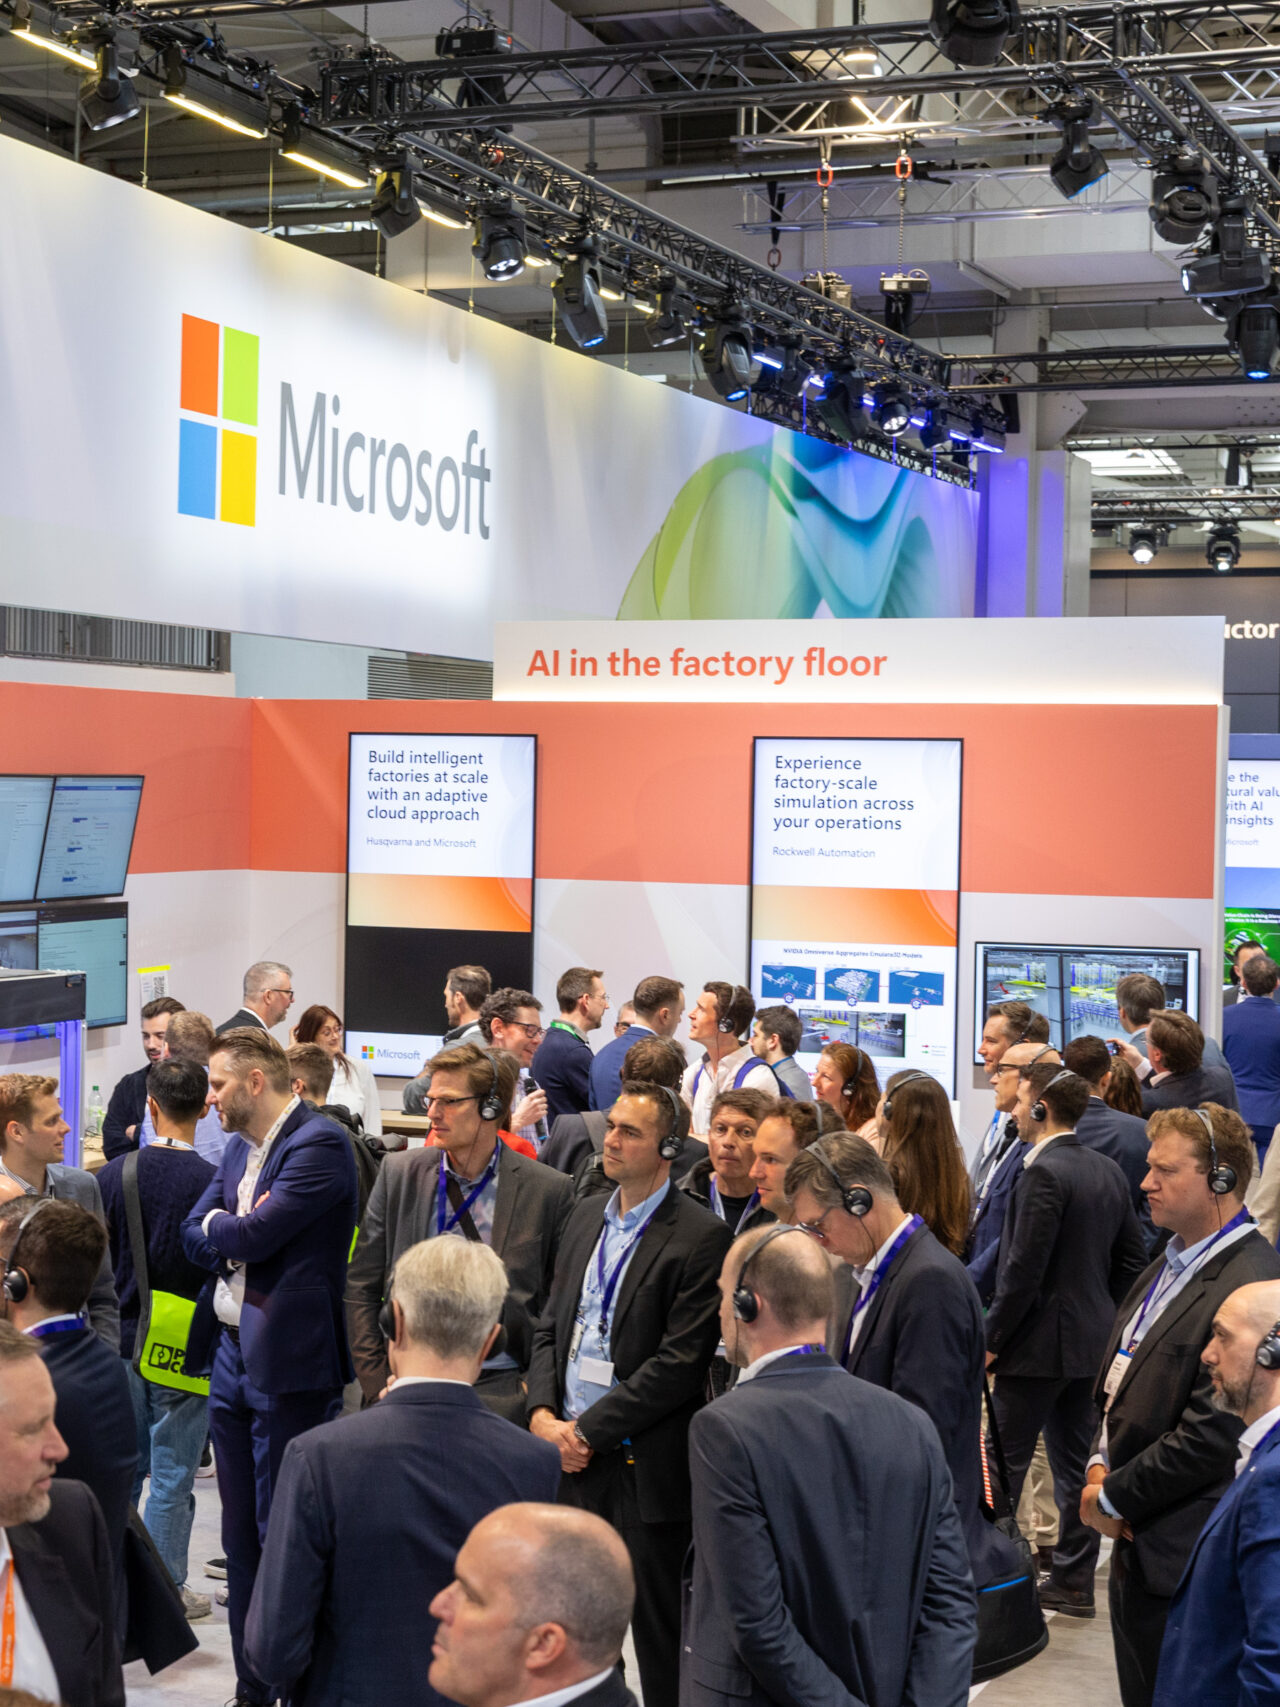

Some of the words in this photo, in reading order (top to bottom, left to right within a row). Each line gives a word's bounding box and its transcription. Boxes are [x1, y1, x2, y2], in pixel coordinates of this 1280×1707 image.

[278, 380, 491, 540] Microsoft
[527, 649, 560, 677] AI
[570, 648, 598, 677] in
[607, 647, 661, 677] the
[670, 647, 794, 686] factory
[803, 646, 888, 677] floor
[368, 750, 404, 763] Build
[410, 750, 483, 768] intelligent
[775, 755, 862, 773] Experience
[368, 768, 430, 783] factories
[434, 771, 448, 783] at
[453, 770, 488, 784] scale
[774, 774, 878, 793] factory-scale
[1240, 772, 1259, 782] the
[367, 787, 398, 801] with
[403, 791, 420, 801] an
[425, 788, 488, 805] adaptive
[774, 794, 858, 809] simulation
[863, 799, 914, 811] across
[367, 805, 406, 819] cloud
[411, 807, 479, 823] approach
[1251, 801, 1263, 811] AI
[773, 817, 809, 832] your
[814, 816, 902, 832] operations
[366, 837, 412, 848] Husqvarna
[414, 838, 431, 847] and
[433, 838, 477, 848] Microsoft
[772, 846, 815, 857] Rockwell
[818, 848, 876, 858] Automation
[377, 1048, 421, 1060] Microsoft
